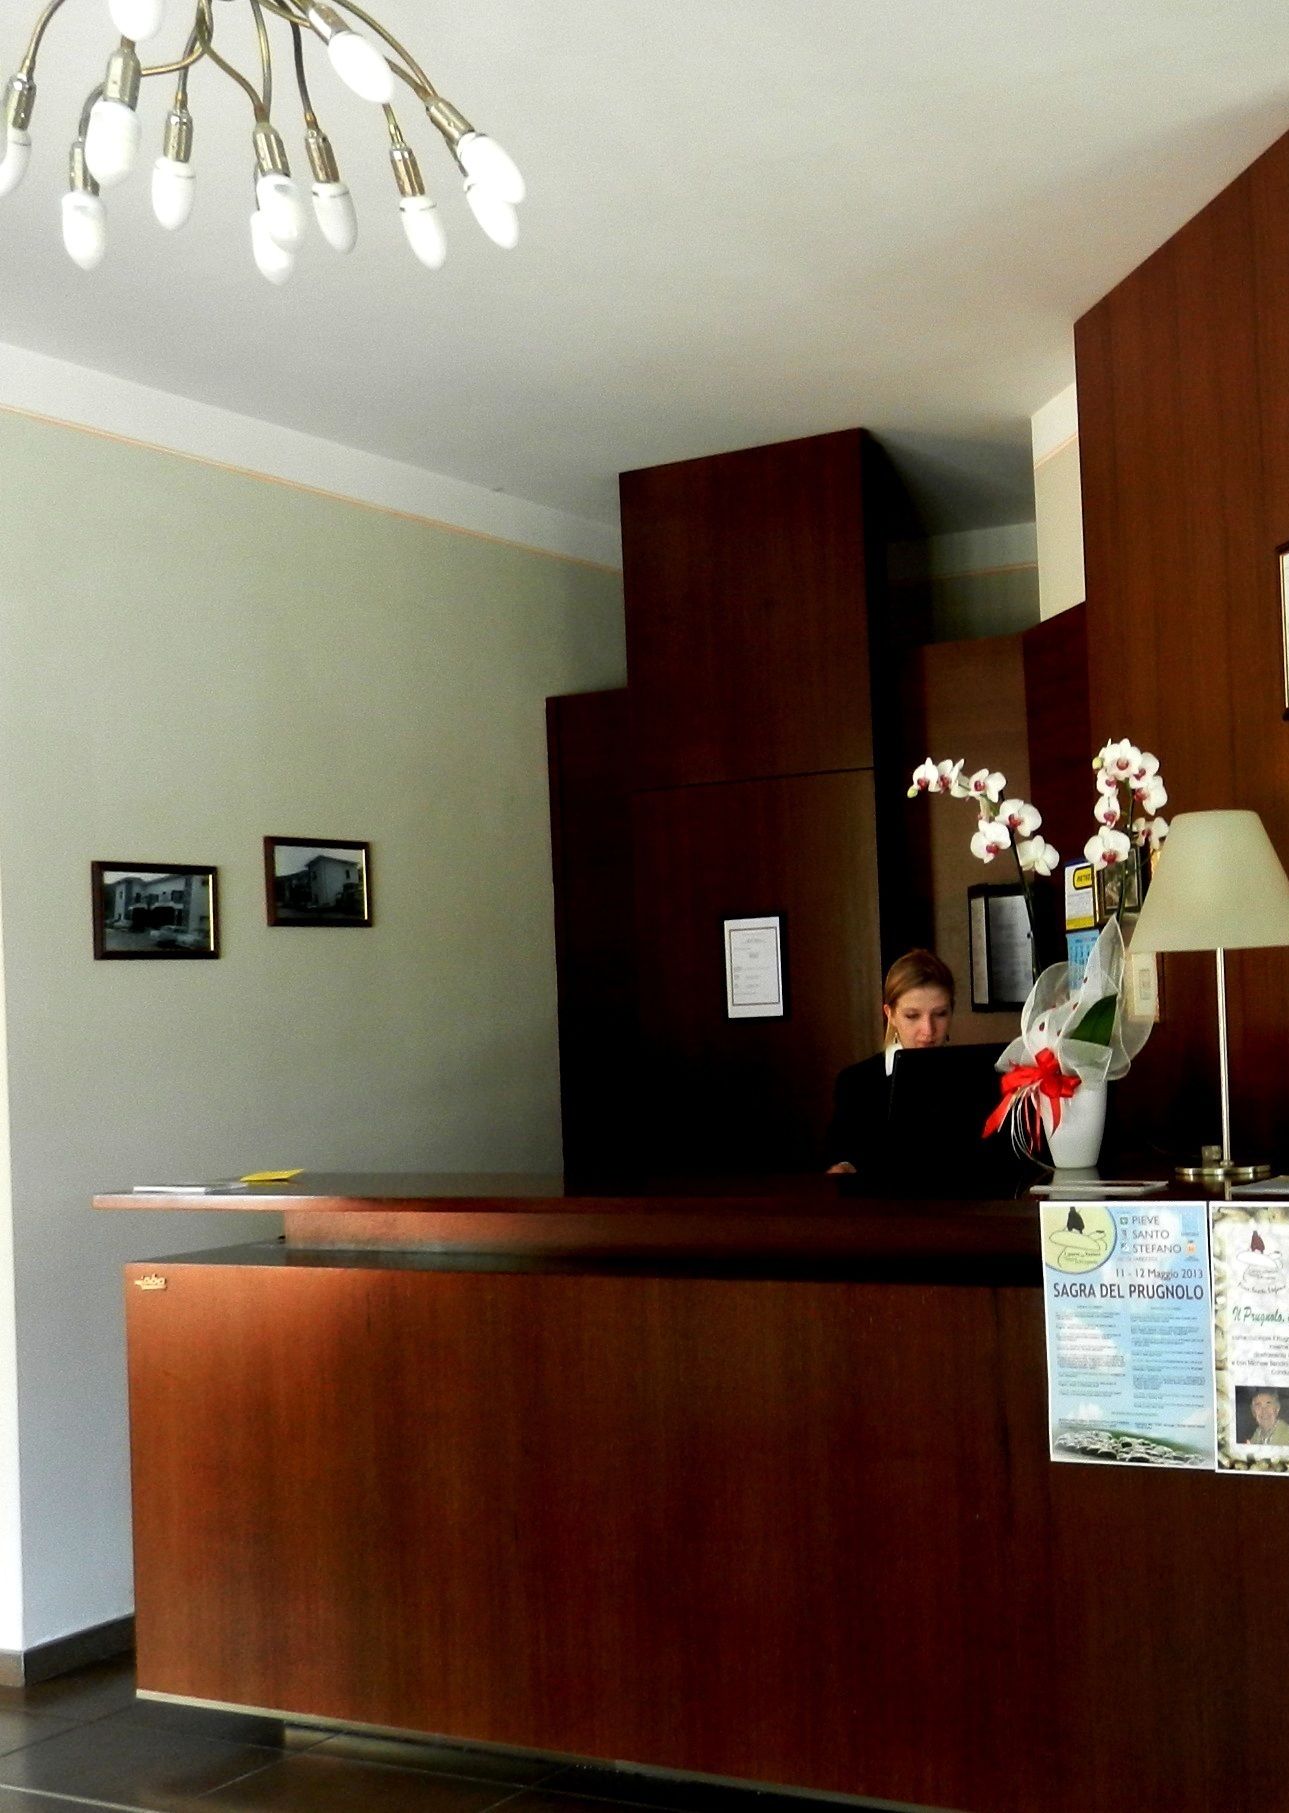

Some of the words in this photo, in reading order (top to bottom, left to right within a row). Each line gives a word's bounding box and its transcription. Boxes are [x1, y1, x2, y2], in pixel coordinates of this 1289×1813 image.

[1132, 1216, 1160, 1226] PIEVE
[1132, 1229, 1170, 1240] SANTO
[1132, 1243, 1182, 1254] STEFANO
[1115, 1268, 1124, 1279] 11
[1135, 1269, 1145, 1280] 12
[1147, 1269, 1179, 1282] Maggio
[1181, 1269, 1204, 1280] 2013
[1053, 1282, 1096, 1298] SAGRA
[1100, 1283, 1125, 1299] DEL
[1129, 1284, 1205, 1301] PRUGNOLO
[1232, 1306, 1242, 1321] Il
